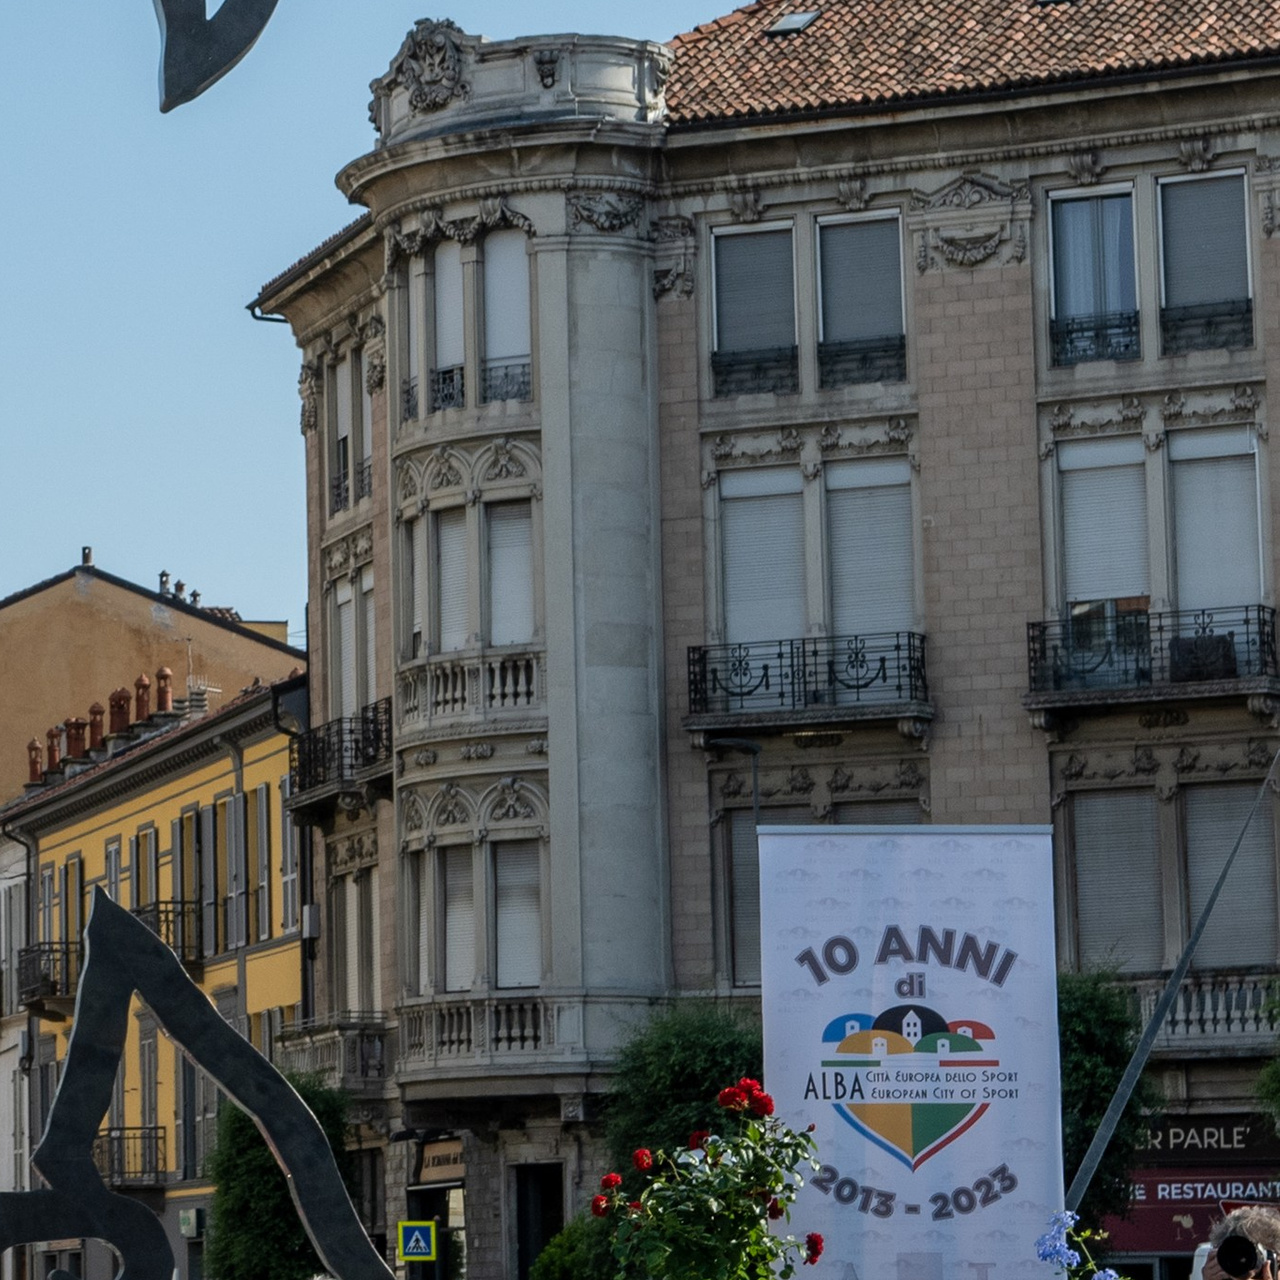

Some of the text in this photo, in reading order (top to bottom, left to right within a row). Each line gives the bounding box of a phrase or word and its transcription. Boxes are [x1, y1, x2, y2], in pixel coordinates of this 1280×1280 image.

[795, 924, 1018, 987] 10 ANNI
[895, 972, 926, 999] di
[804, 1071, 865, 1100] ALBA
[809, 1164, 897, 1218] 2013
[928, 1163, 1019, 1221] 2023
